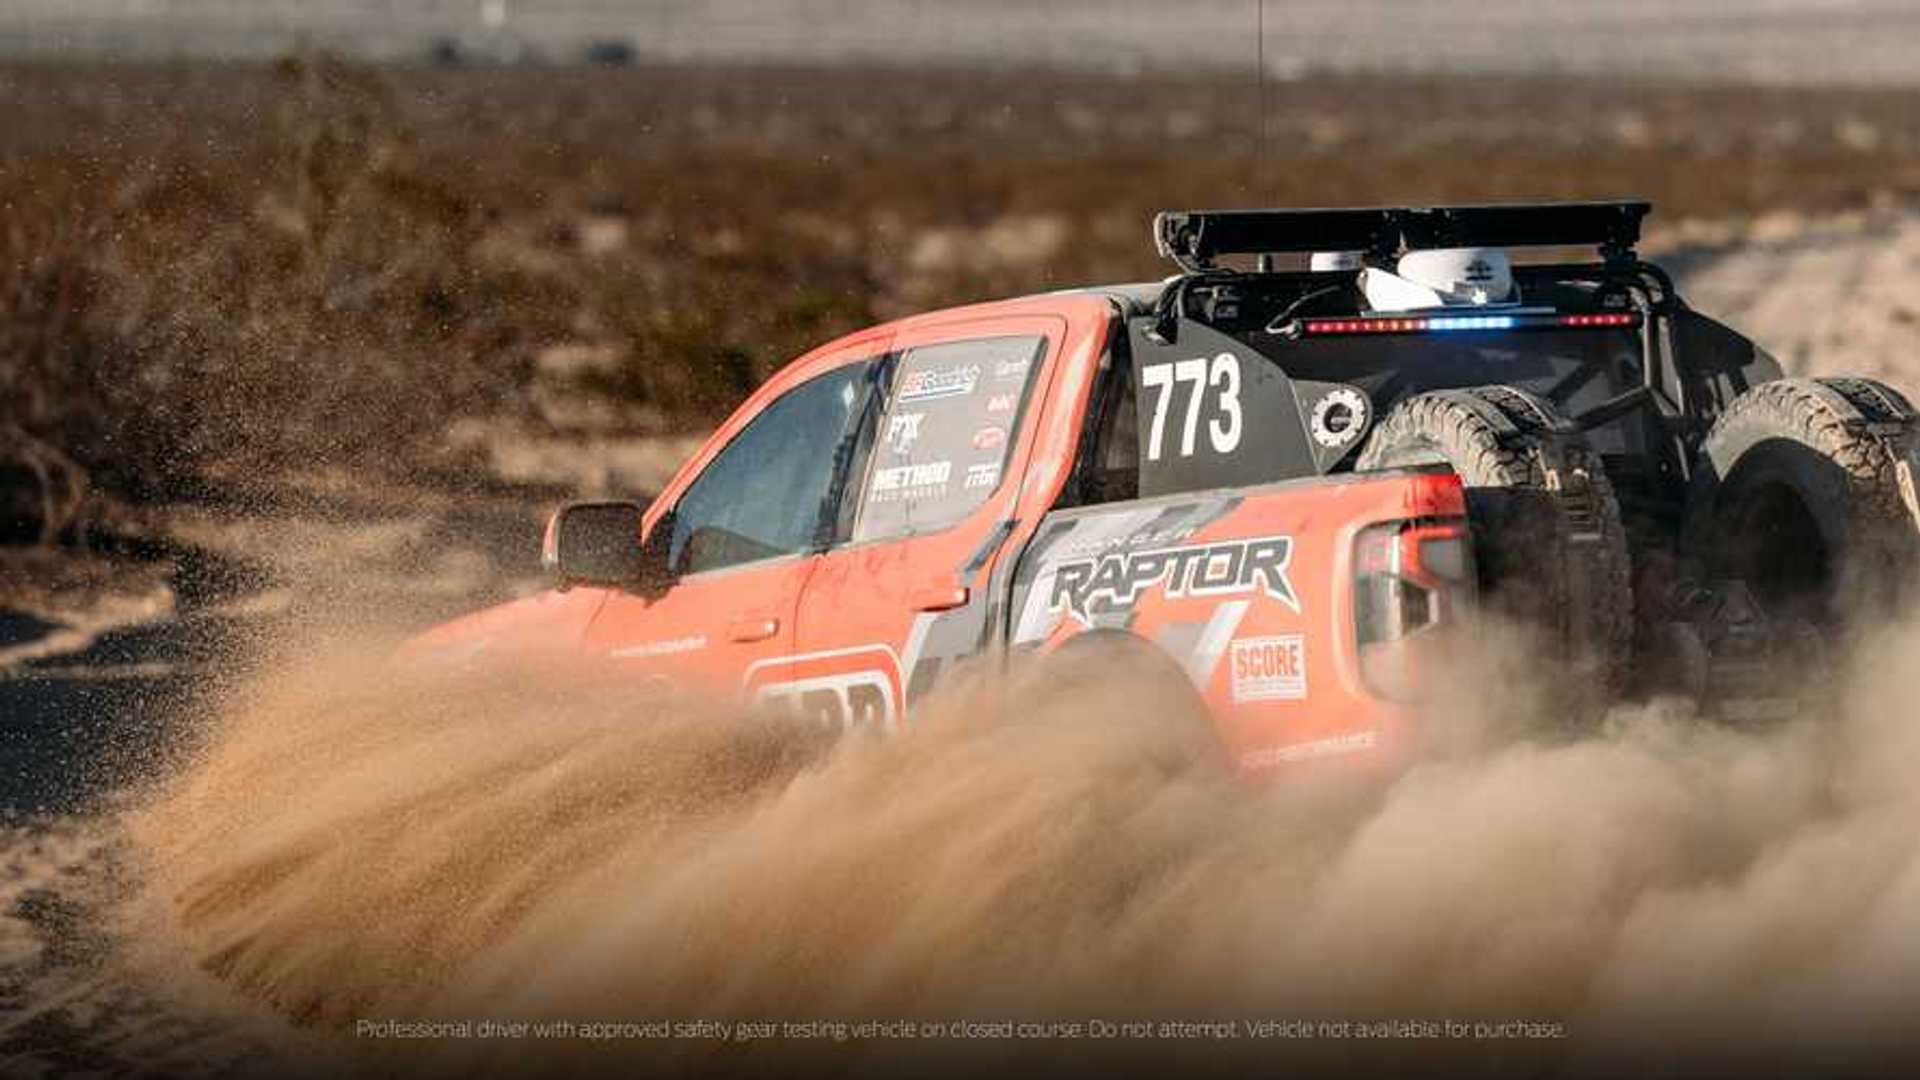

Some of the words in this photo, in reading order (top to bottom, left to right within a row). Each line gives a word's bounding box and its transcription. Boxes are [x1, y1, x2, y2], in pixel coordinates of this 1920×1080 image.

[1142, 352, 1242, 460] 773
[873, 461, 951, 491] METHOD
[1050, 535, 1300, 627] RAPTOR
[1236, 643, 1300, 680] SCORE
